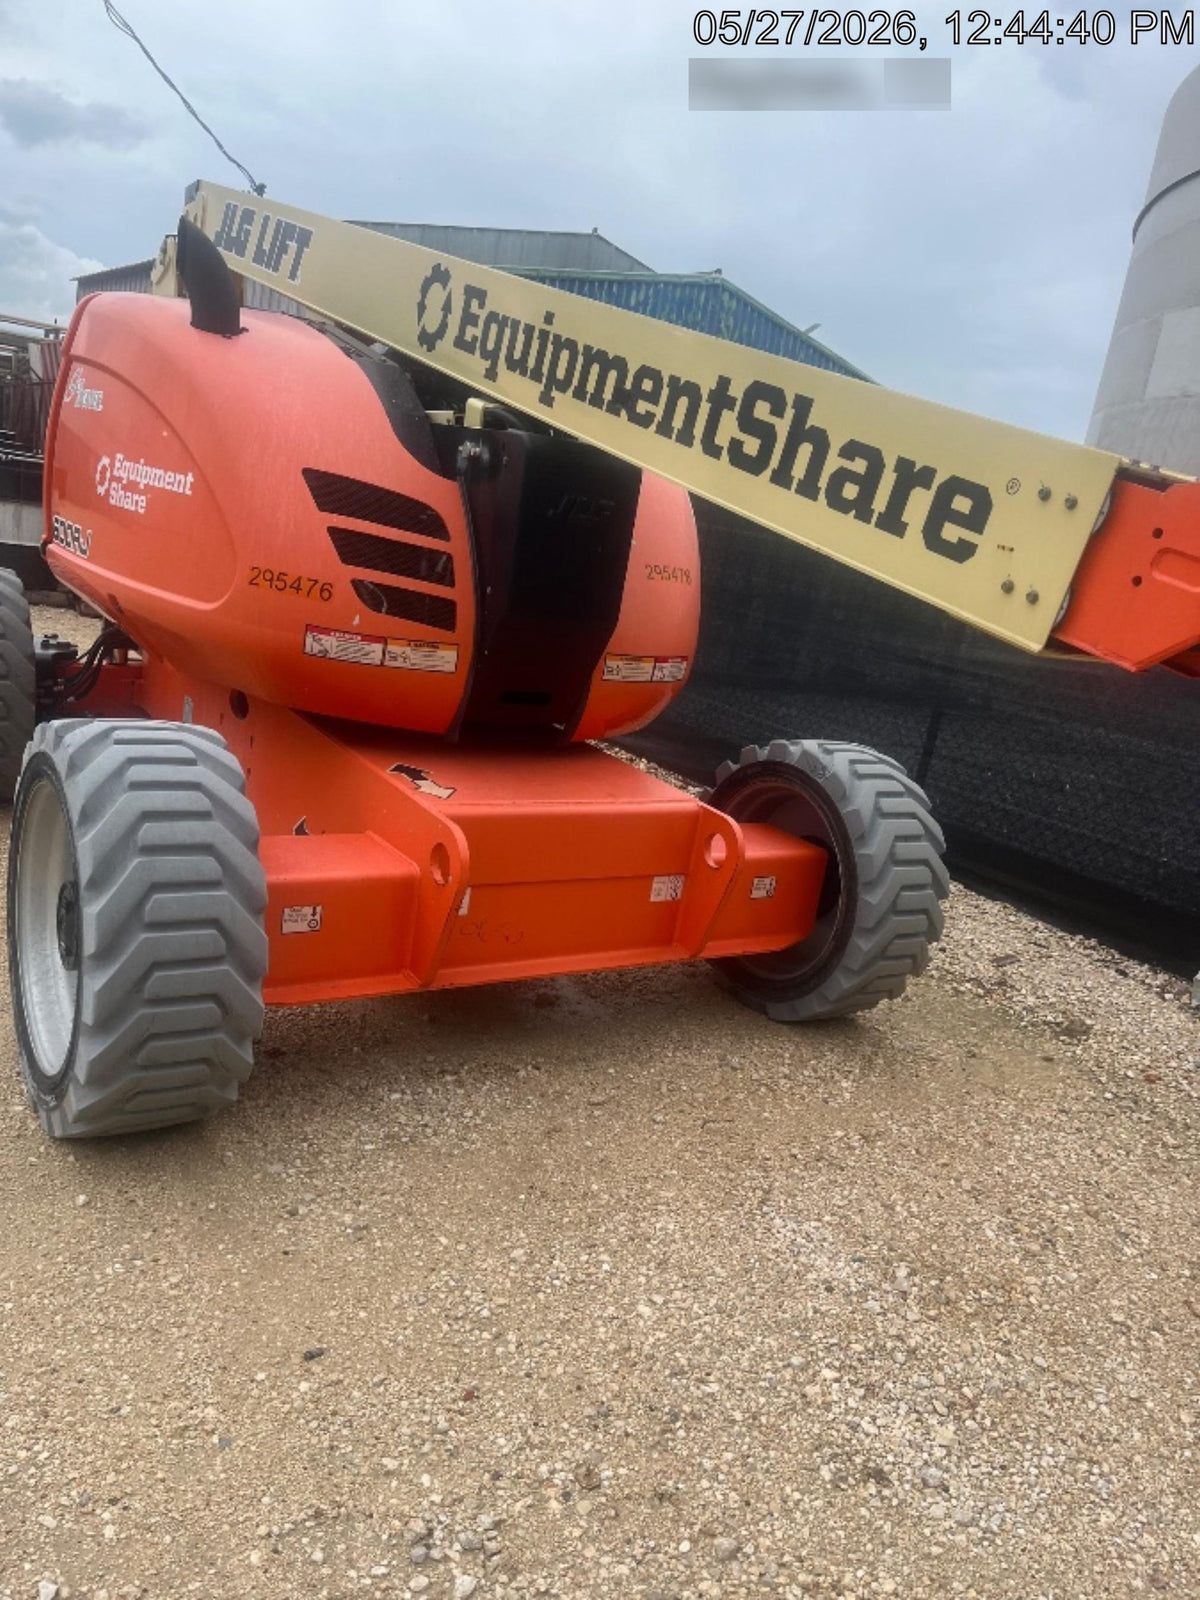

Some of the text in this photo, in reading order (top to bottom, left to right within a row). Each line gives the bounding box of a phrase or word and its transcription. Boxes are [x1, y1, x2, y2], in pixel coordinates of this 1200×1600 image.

[215, 202, 314, 284] JLG LIFT
[454, 285, 992, 563] EquipmentShare
[113, 453, 194, 496] Equipment
[109, 481, 147, 513] Share
[248, 566, 333, 601] 295476
